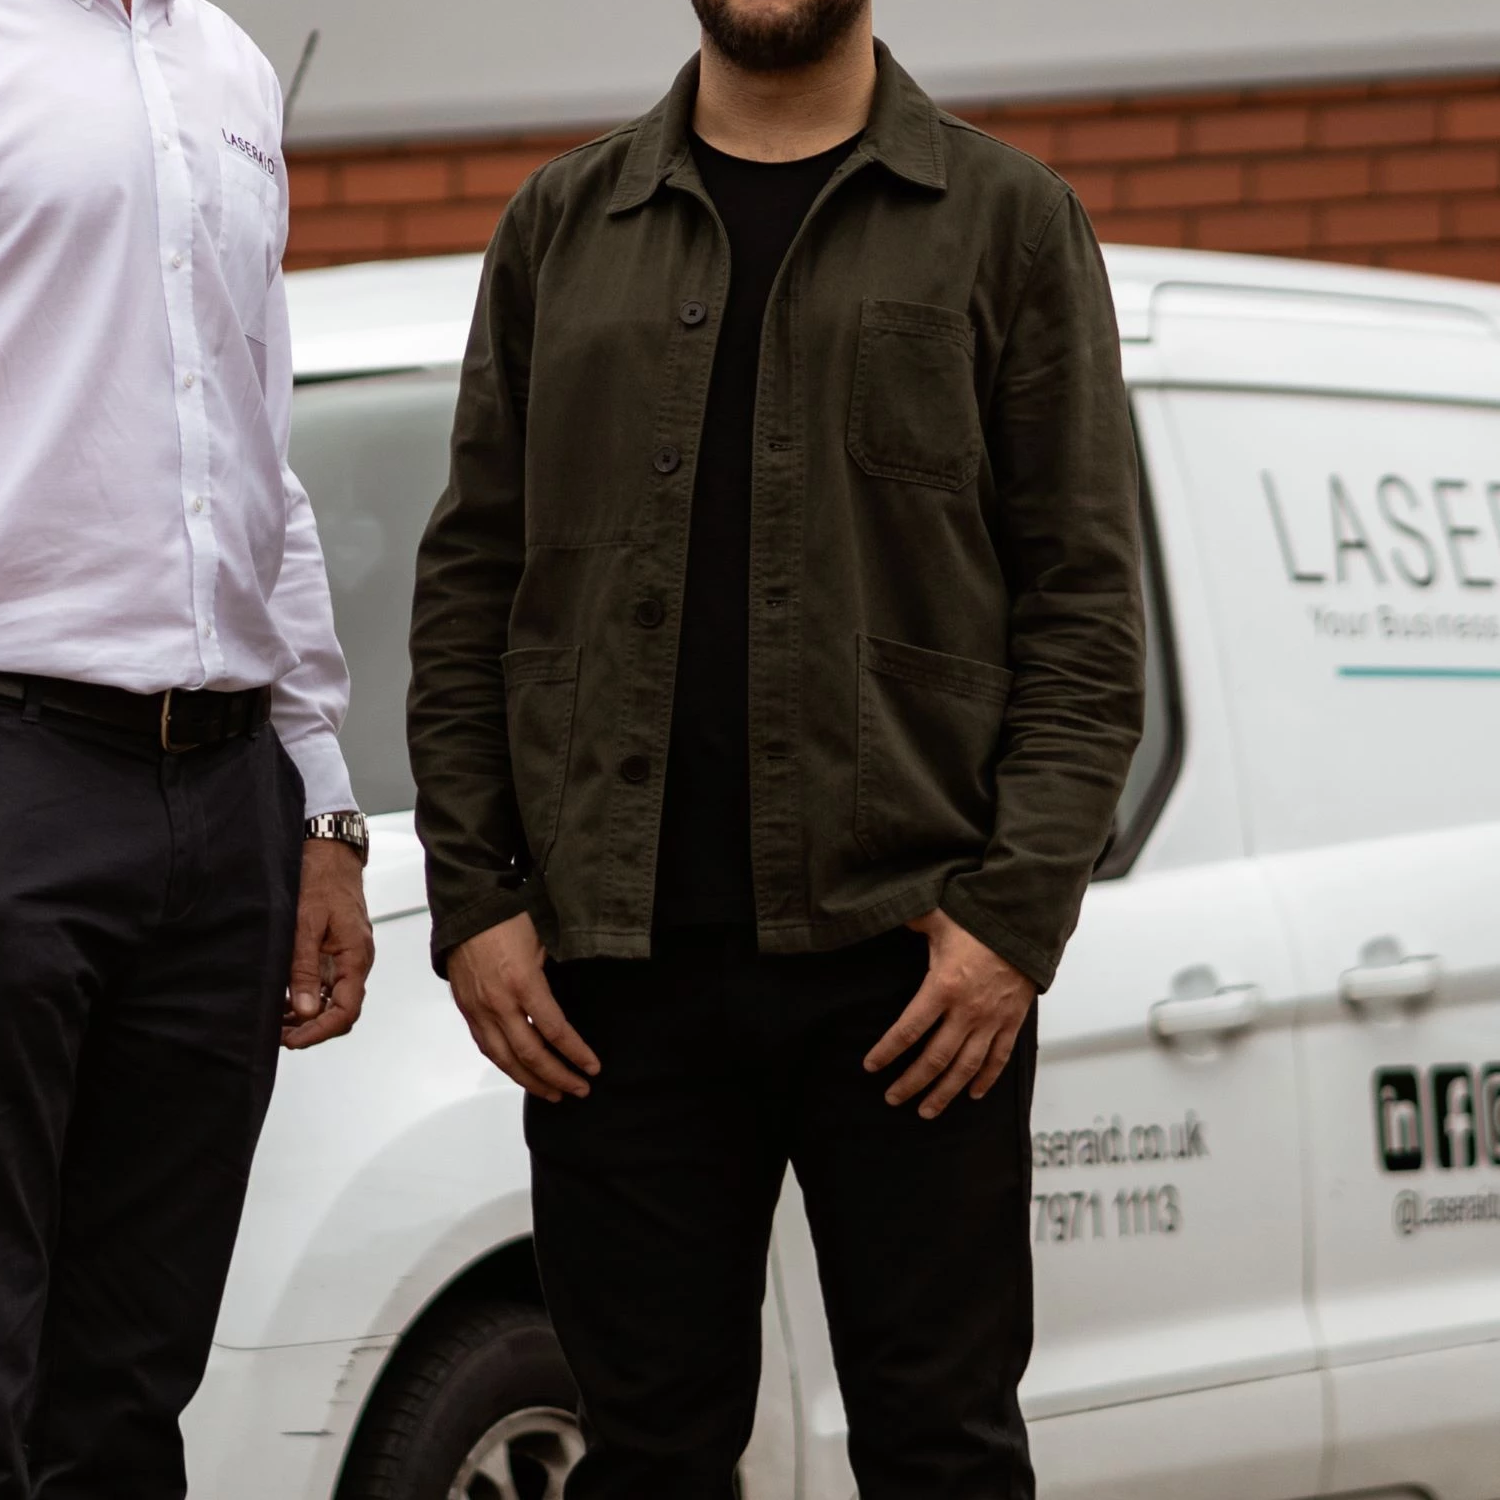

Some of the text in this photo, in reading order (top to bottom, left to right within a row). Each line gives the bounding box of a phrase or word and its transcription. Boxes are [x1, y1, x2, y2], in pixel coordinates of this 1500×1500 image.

[221, 128, 275, 175] LASERAID
[1032, 1111, 1207, 1168] seraid.co.uk
[1114, 1184, 1181, 1237] 1113
